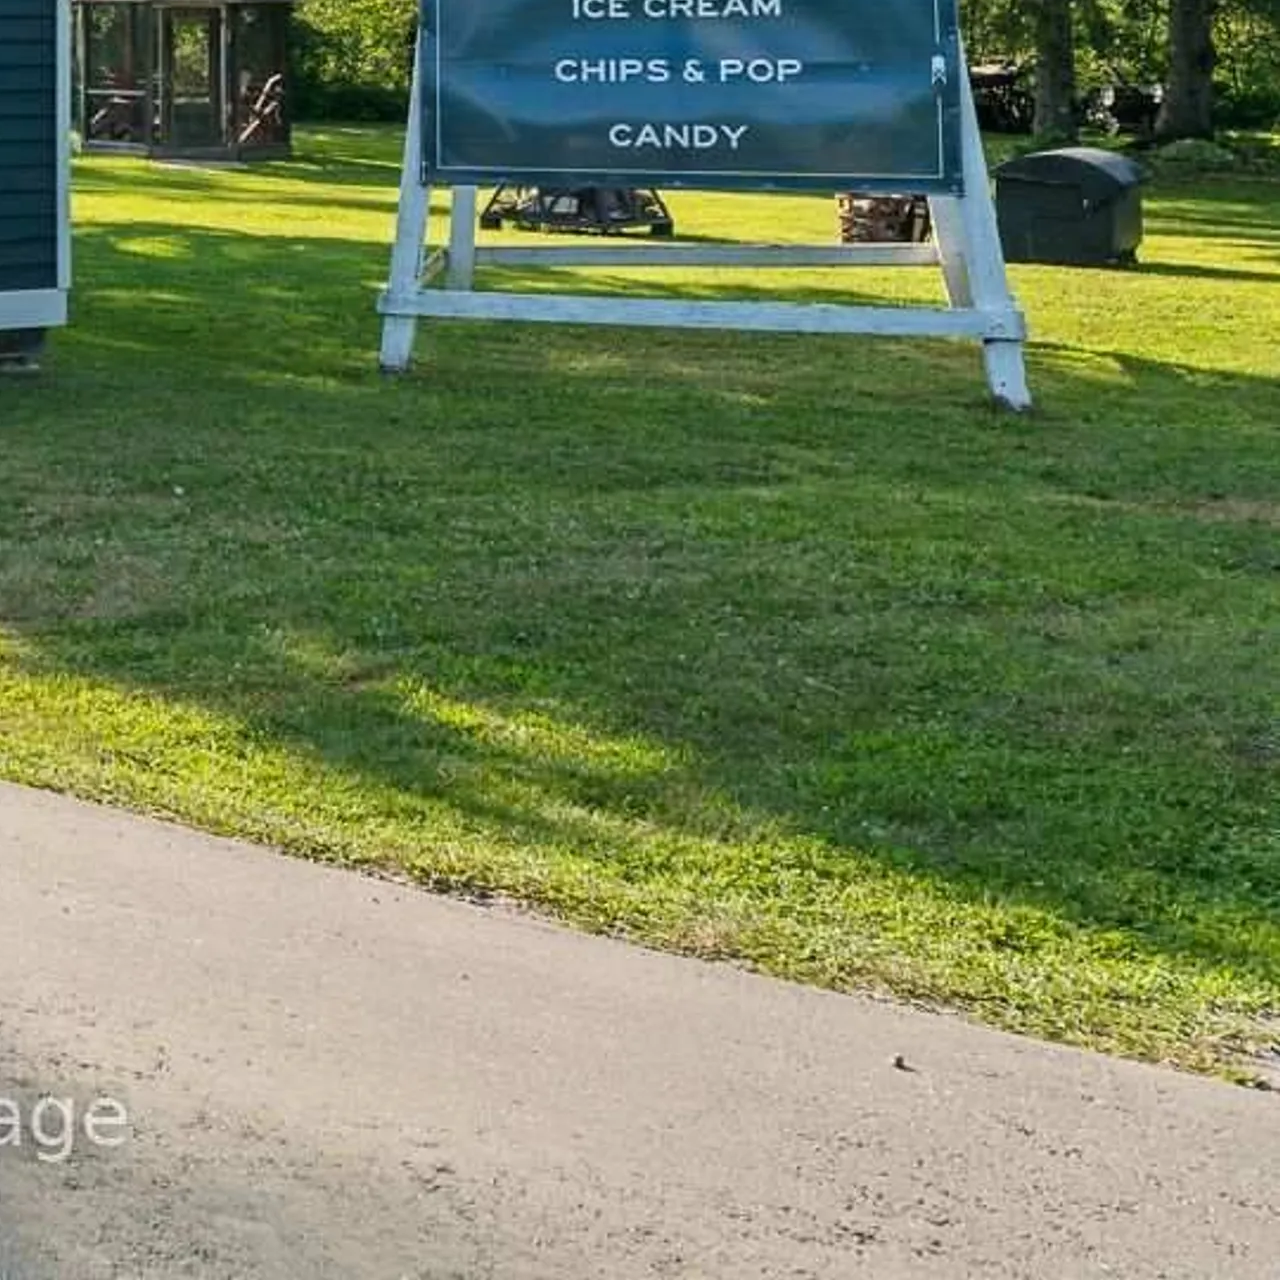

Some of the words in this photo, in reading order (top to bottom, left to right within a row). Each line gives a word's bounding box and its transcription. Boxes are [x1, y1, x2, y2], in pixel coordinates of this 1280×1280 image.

[554, 58, 671, 83] CHIPS
[682, 60, 705, 83] &
[719, 58, 803, 83] POP
[608, 123, 749, 149] CANDY
